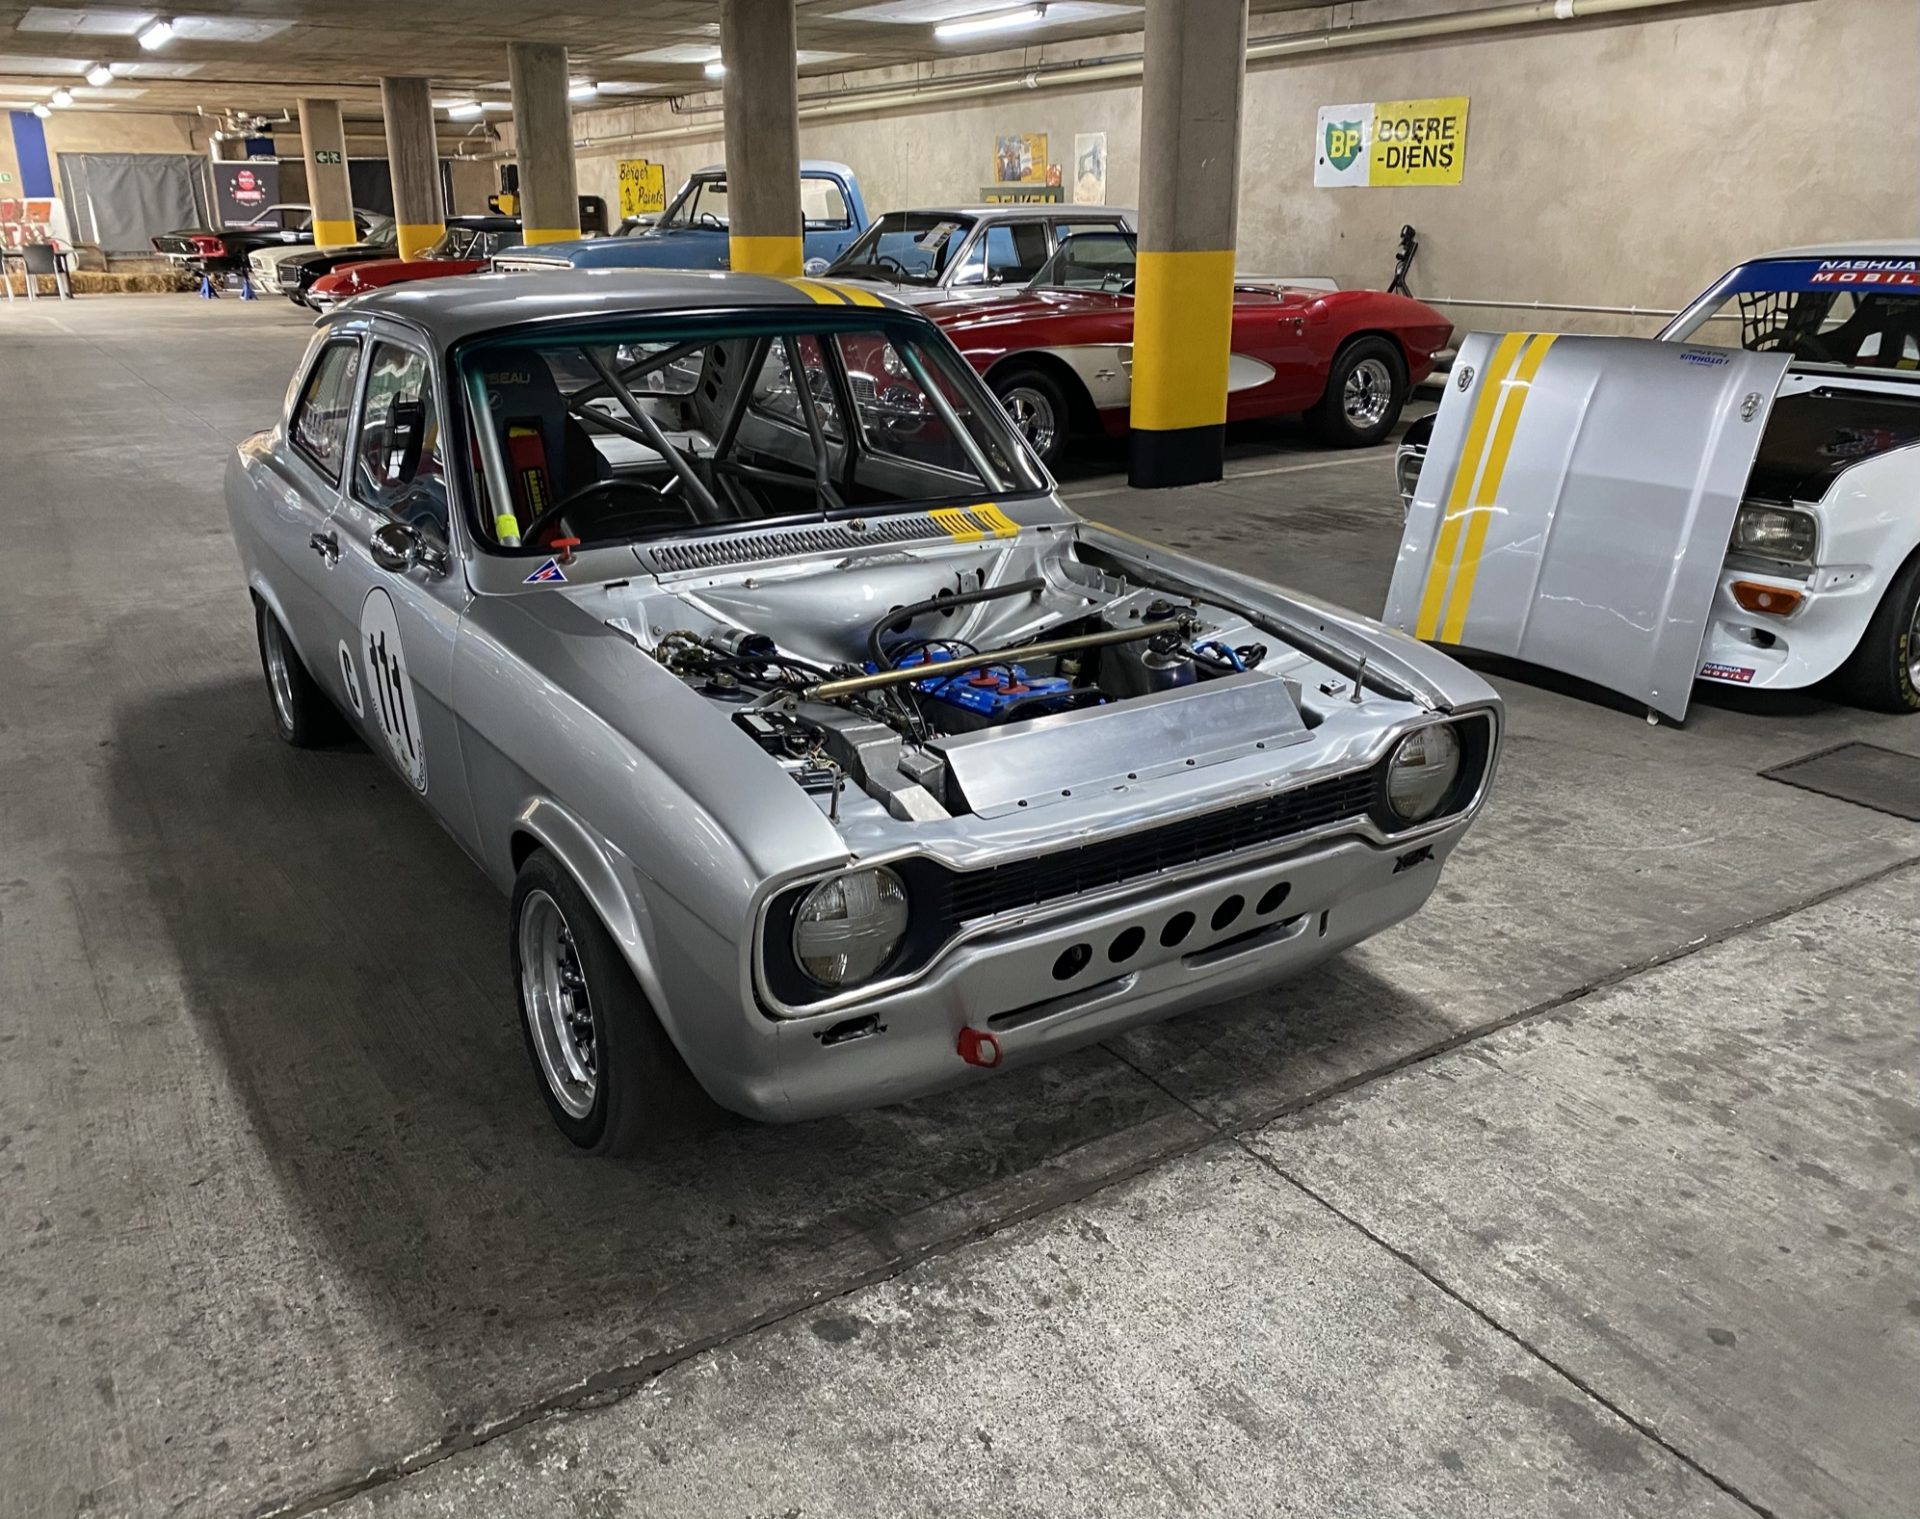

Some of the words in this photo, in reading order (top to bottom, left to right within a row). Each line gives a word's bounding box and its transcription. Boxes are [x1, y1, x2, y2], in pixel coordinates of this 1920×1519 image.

[1378, 117, 1456, 142] BOERE
[1330, 129, 1360, 158] BP
[1377, 144, 1454, 168] -DIENS
[620, 163, 648, 186] Berger
[638, 186, 663, 205] Paints
[1818, 260, 1916, 270] NASHUA
[484, 372, 531, 384] BEAU
[1702, 669, 1750, 680] MOBILE
[1705, 663, 1742, 673] NASHUA
[369, 630, 416, 761] 111
